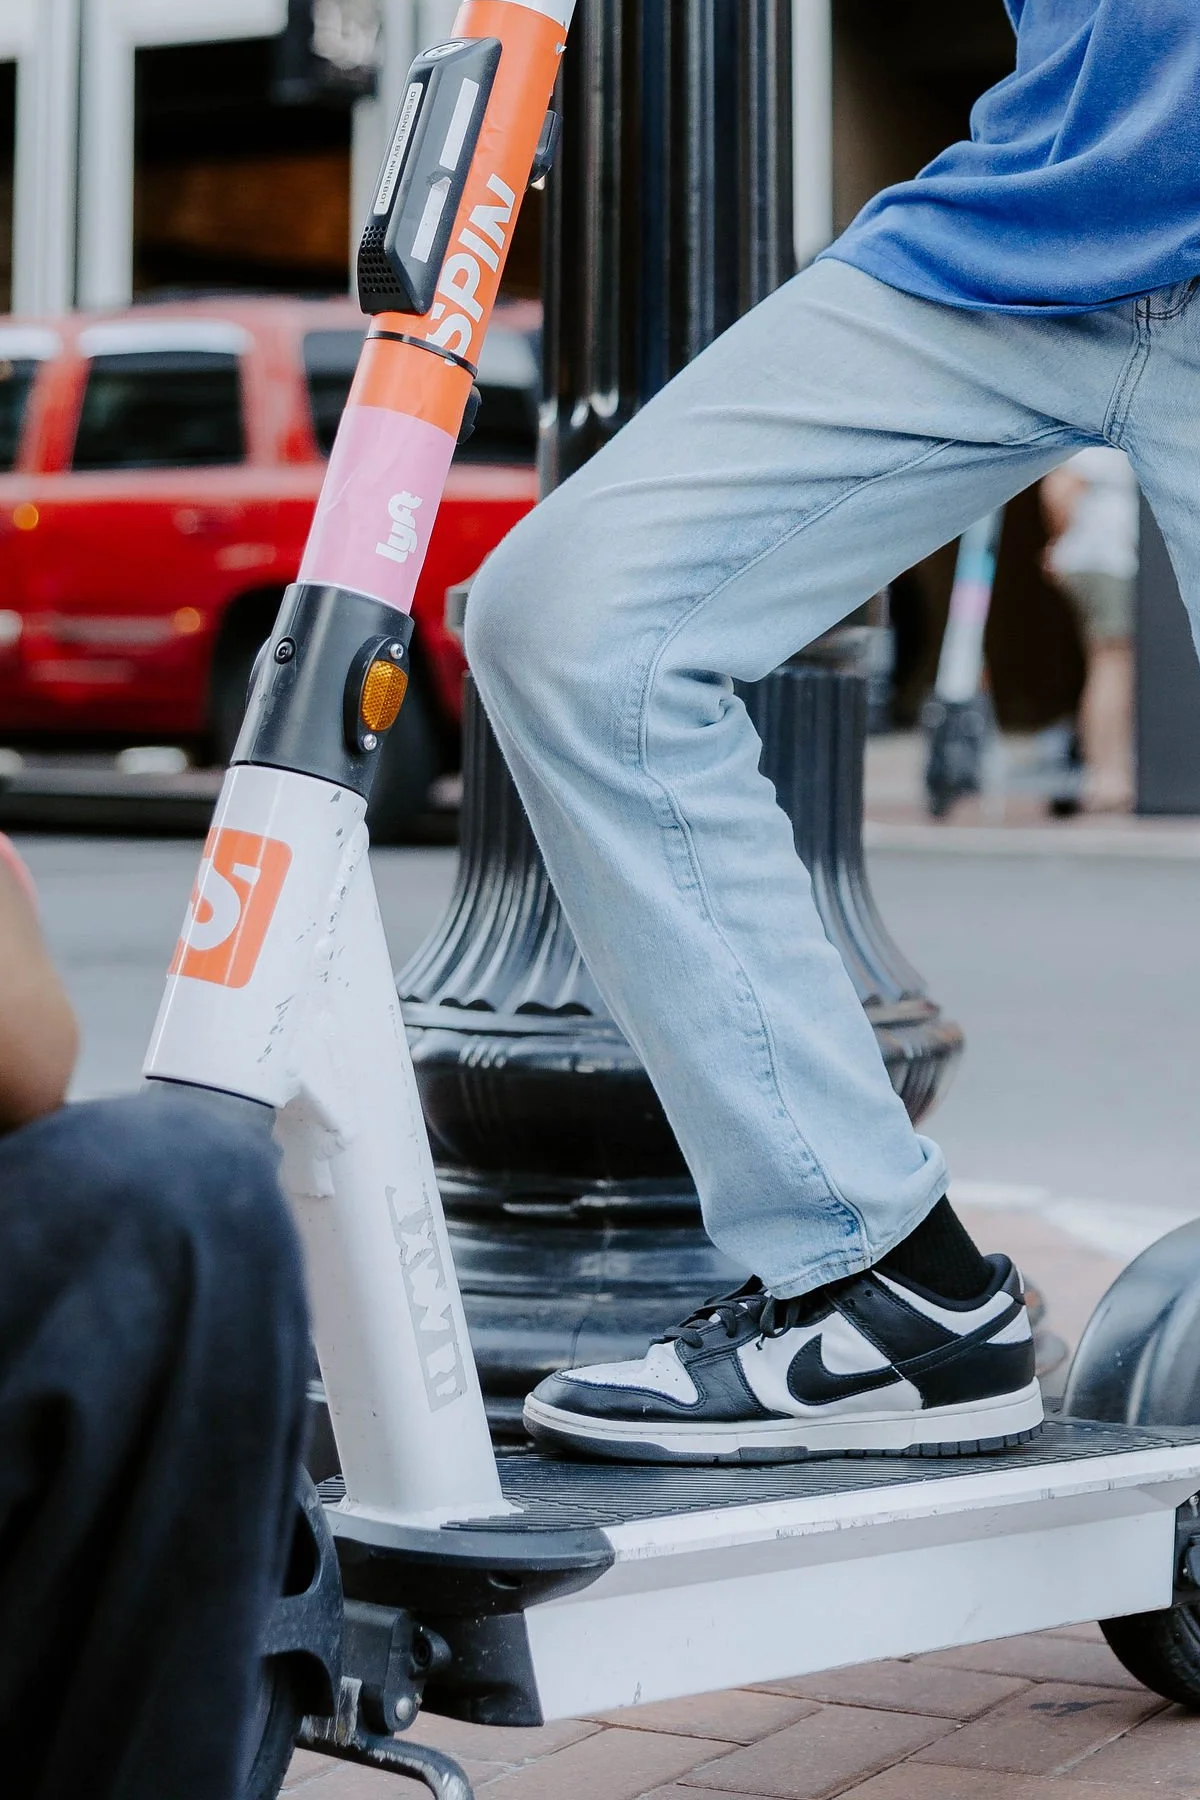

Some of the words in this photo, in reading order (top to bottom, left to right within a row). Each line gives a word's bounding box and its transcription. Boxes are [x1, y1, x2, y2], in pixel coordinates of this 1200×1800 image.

[397, 91, 417, 143] DESIGNED
[393, 145, 401, 159] BY
[379, 160, 397, 206] NINEBOT
[426, 173, 516, 367] SPIN
[375, 489, 423, 564] lyft
